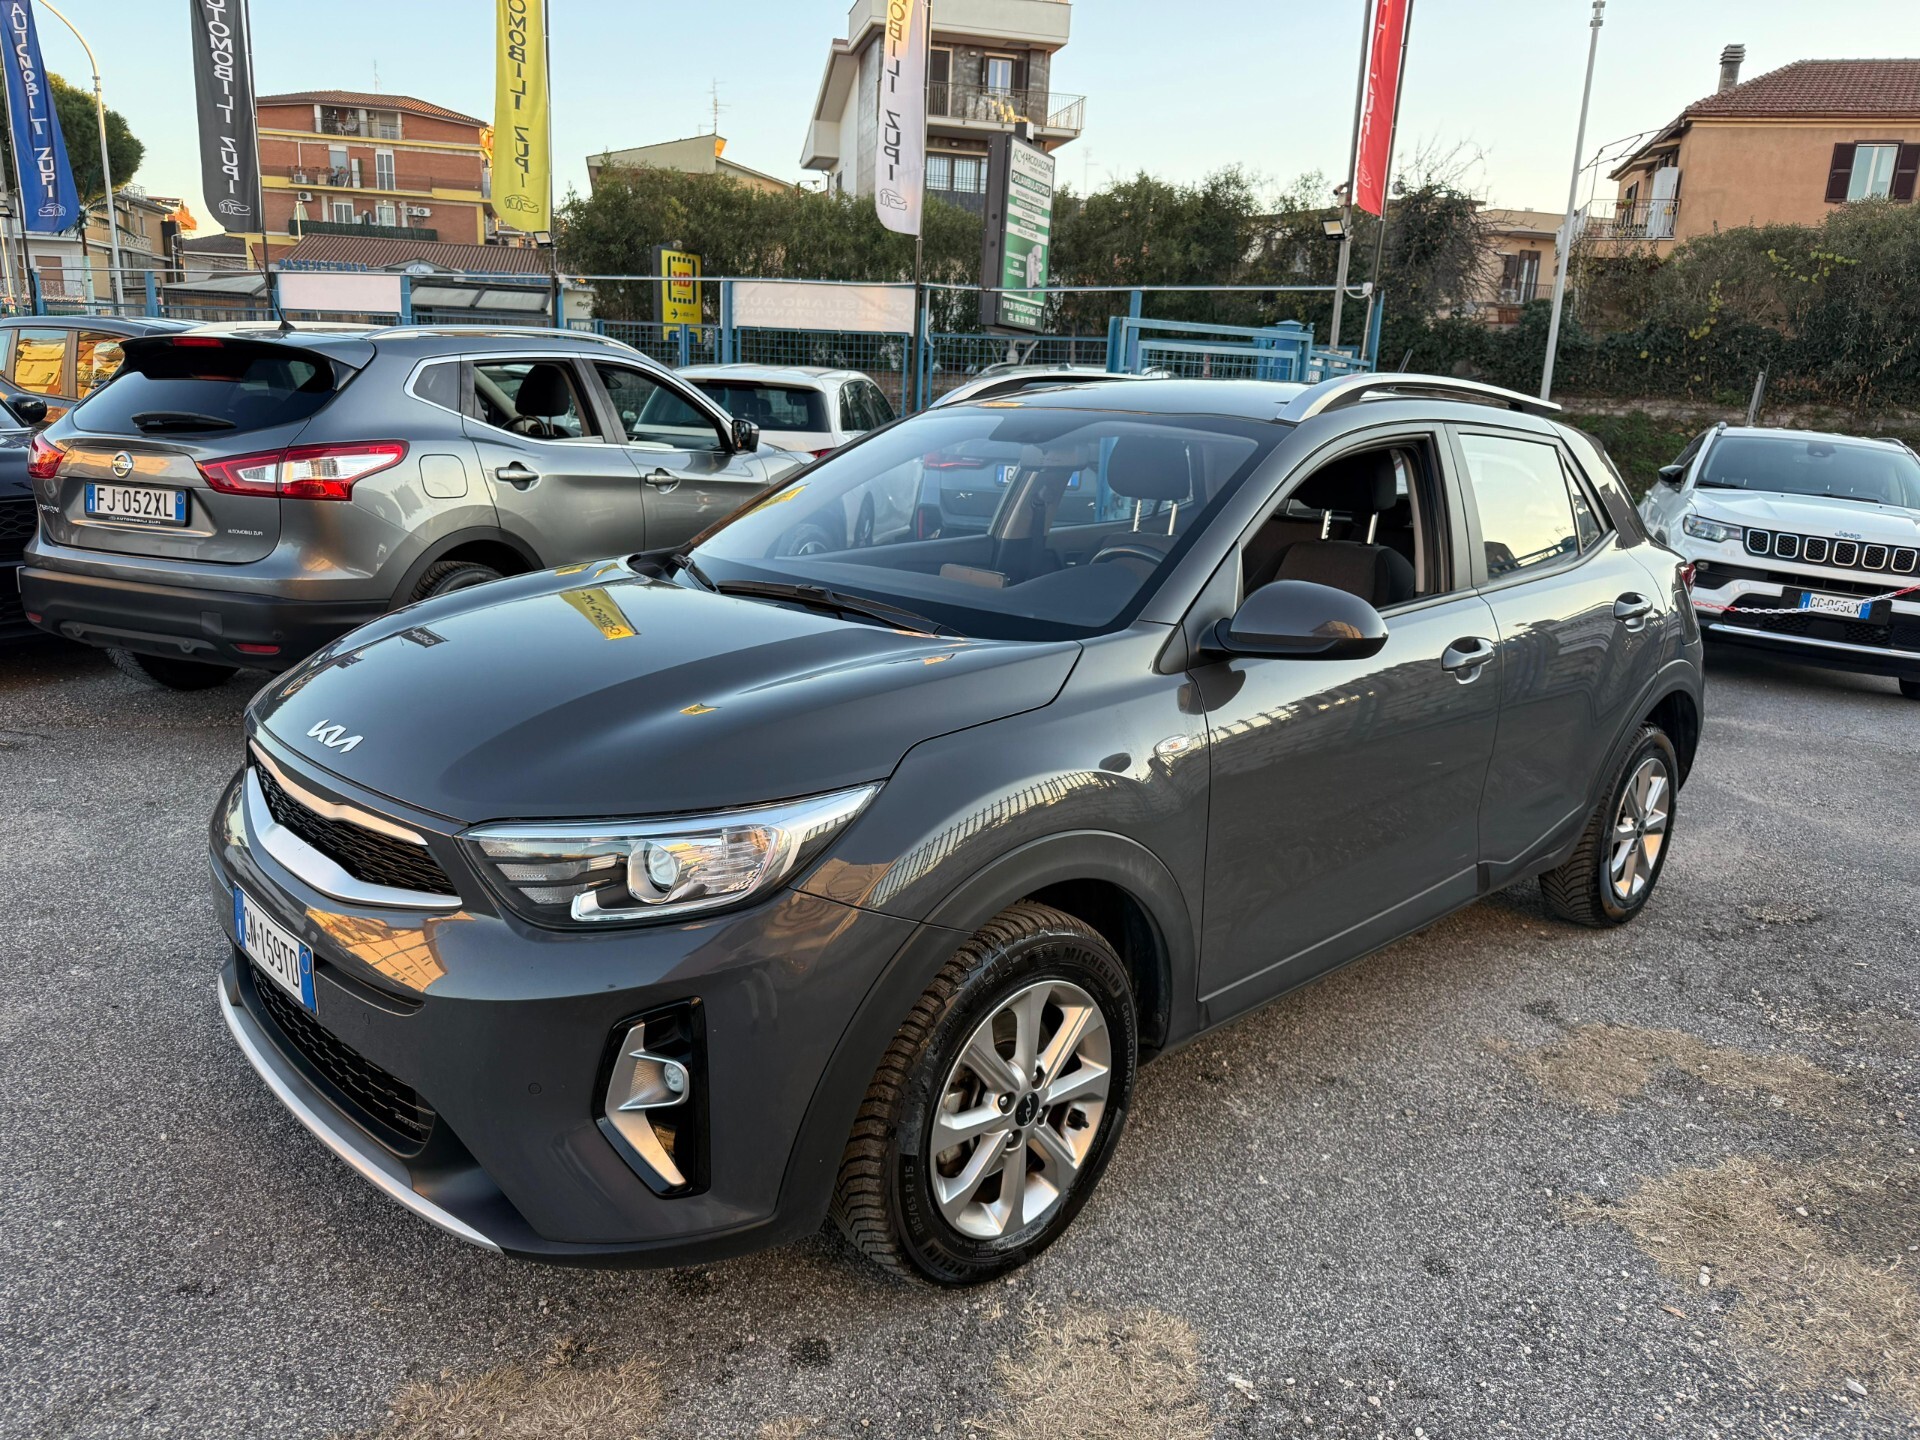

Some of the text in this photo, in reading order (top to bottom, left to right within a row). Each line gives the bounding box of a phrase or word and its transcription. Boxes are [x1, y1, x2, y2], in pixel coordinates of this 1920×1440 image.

[34, 147, 56, 198] ZUPI
[672, 271, 691, 288] MD
[1834, 530, 1862, 540] Jeep
[1063, 946, 1122, 994] MICHELIN
[905, 1184, 915, 1192] R
